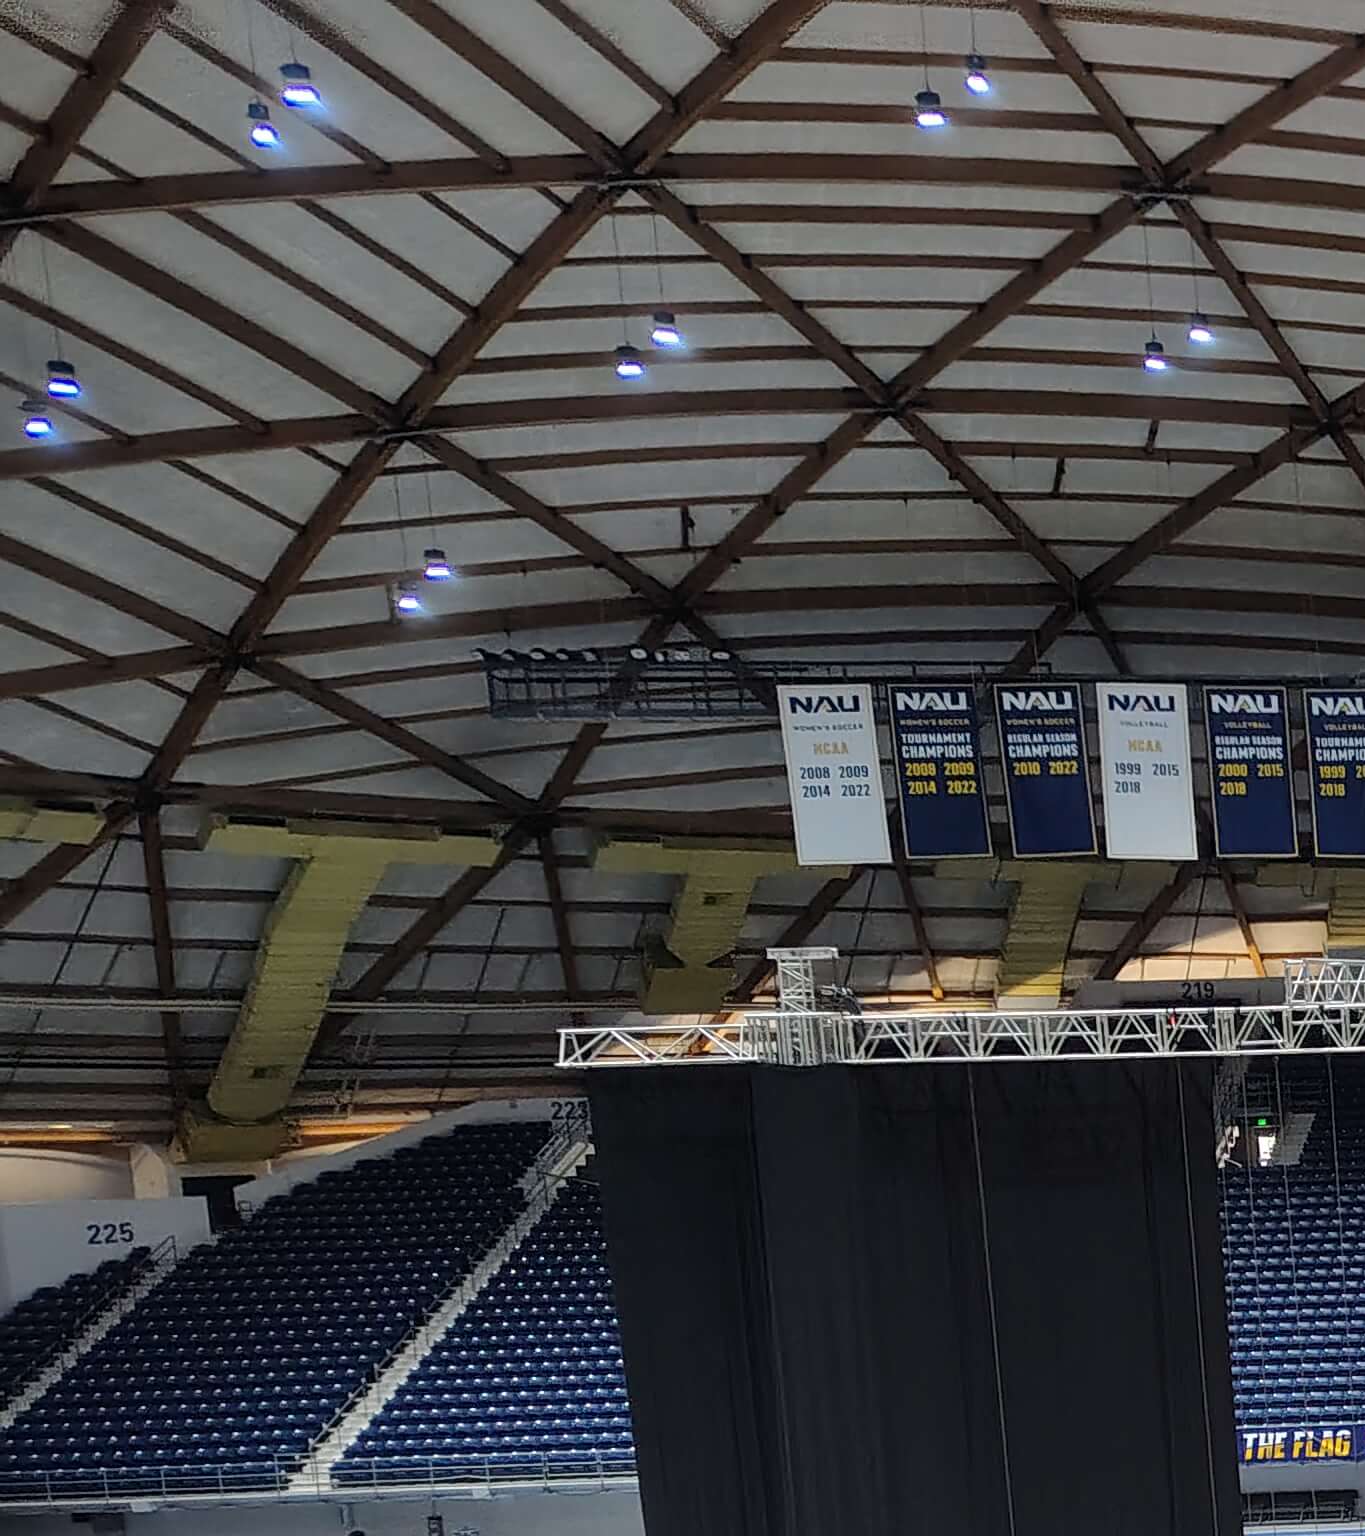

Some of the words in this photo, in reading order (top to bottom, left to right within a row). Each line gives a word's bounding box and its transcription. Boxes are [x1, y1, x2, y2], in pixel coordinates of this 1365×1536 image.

[789, 696, 860, 713] NAU
[895, 692, 968, 711] NAU
[1002, 692, 1073, 711] NAU
[1108, 695, 1176, 712] NAU
[1210, 694, 1279, 713] NAU
[902, 733, 971, 743] TOURNAMENT
[1007, 734, 1044, 743] REGULAR
[1046, 733, 1077, 742] SEASON
[1252, 736, 1283, 745] SEASON
[902, 745, 973, 758] CHAMPIONS
[1008, 744, 1078, 758] CHAMPIONS
[1216, 747, 1283, 760] CHAMPIONS
[801, 767, 830, 779] 2008
[839, 766, 869, 778] 2009
[1049, 761, 1078, 775] 2022
[1115, 763, 1141, 775] 1999
[1153, 763, 1179, 776] 2015
[1218, 764, 1248, 776] 2000
[1257, 765, 1284, 776] 2015
[803, 786, 830, 798] 2014
[842, 784, 871, 797] 2022
[908, 782, 936, 794] 2014
[947, 781, 976, 794] 2022
[1114, 781, 1140, 793] 2018
[87, 1222, 134, 1244] 225
[1243, 1431, 1287, 1460] THE
[1293, 1430, 1351, 1458] FLAG
